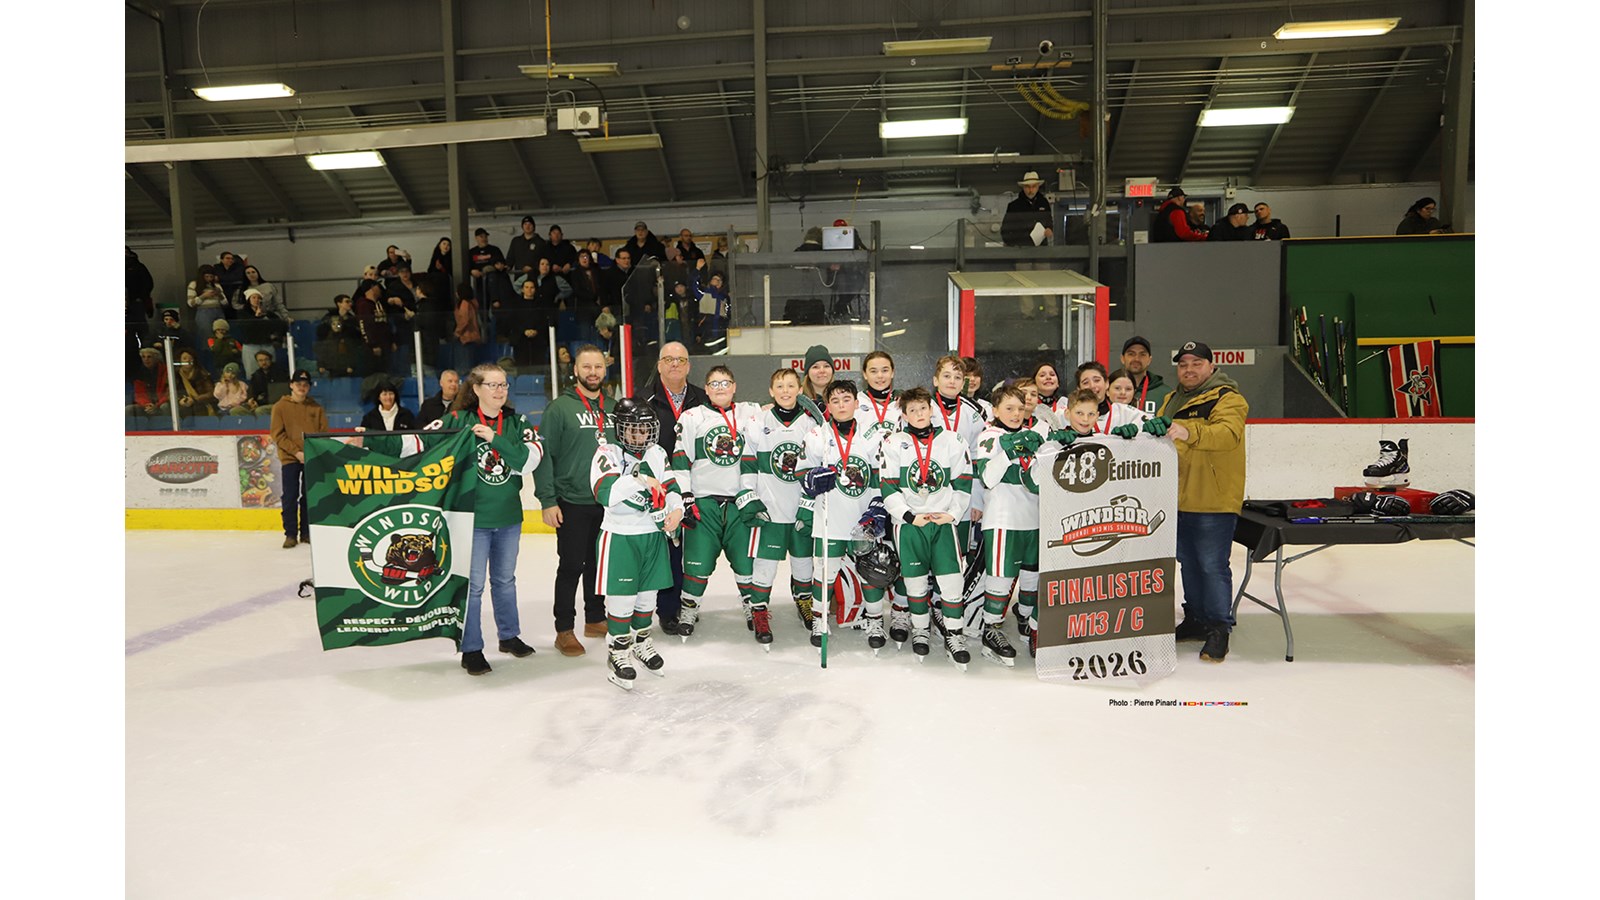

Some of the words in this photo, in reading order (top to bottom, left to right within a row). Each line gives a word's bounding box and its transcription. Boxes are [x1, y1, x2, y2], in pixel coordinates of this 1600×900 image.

[1261, 41, 1267, 49] 6
[1129, 184, 1152, 196] SORTIE
[791, 359, 851, 371] PUON
[773, 443, 801, 461] WINDSO
[421, 455, 456, 477] DE
[782, 472, 795, 480] WIL
[1108, 459, 1162, 481] Édition
[337, 471, 453, 495] WINDSO
[1061, 506, 1150, 535] WINDSOR
[384, 580, 432, 602] WILD
[1047, 567, 1165, 607] FINALISTES
[343, 617, 396, 625] RESPECT
[1067, 611, 1109, 639] M13
[1130, 606, 1144, 632] C
[1068, 649, 1148, 681] 2026
